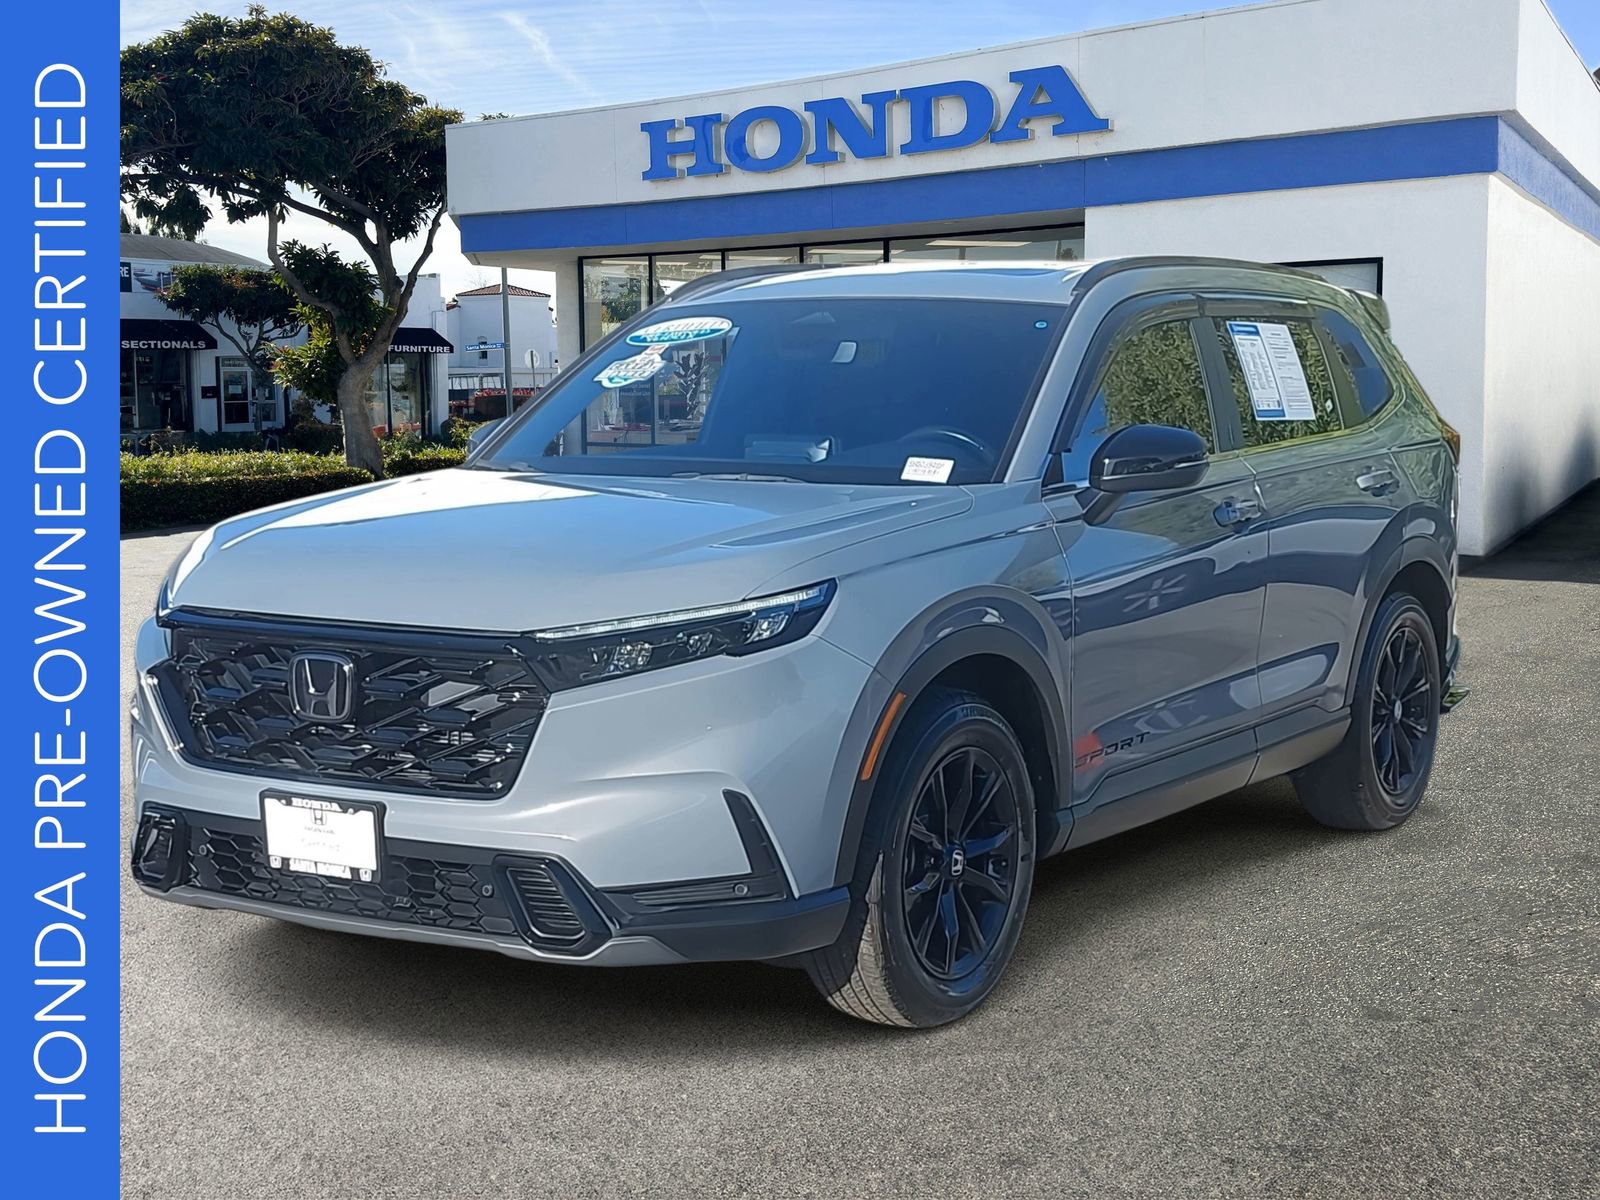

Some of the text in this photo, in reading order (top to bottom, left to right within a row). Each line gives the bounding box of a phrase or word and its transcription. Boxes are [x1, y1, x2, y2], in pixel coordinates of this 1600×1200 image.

[640, 64, 1111, 181] HONDA
[121, 340, 206, 349] SECTIONALS
[388, 345, 450, 353] FURNITURE
[1075, 731, 1150, 768] SPORT
